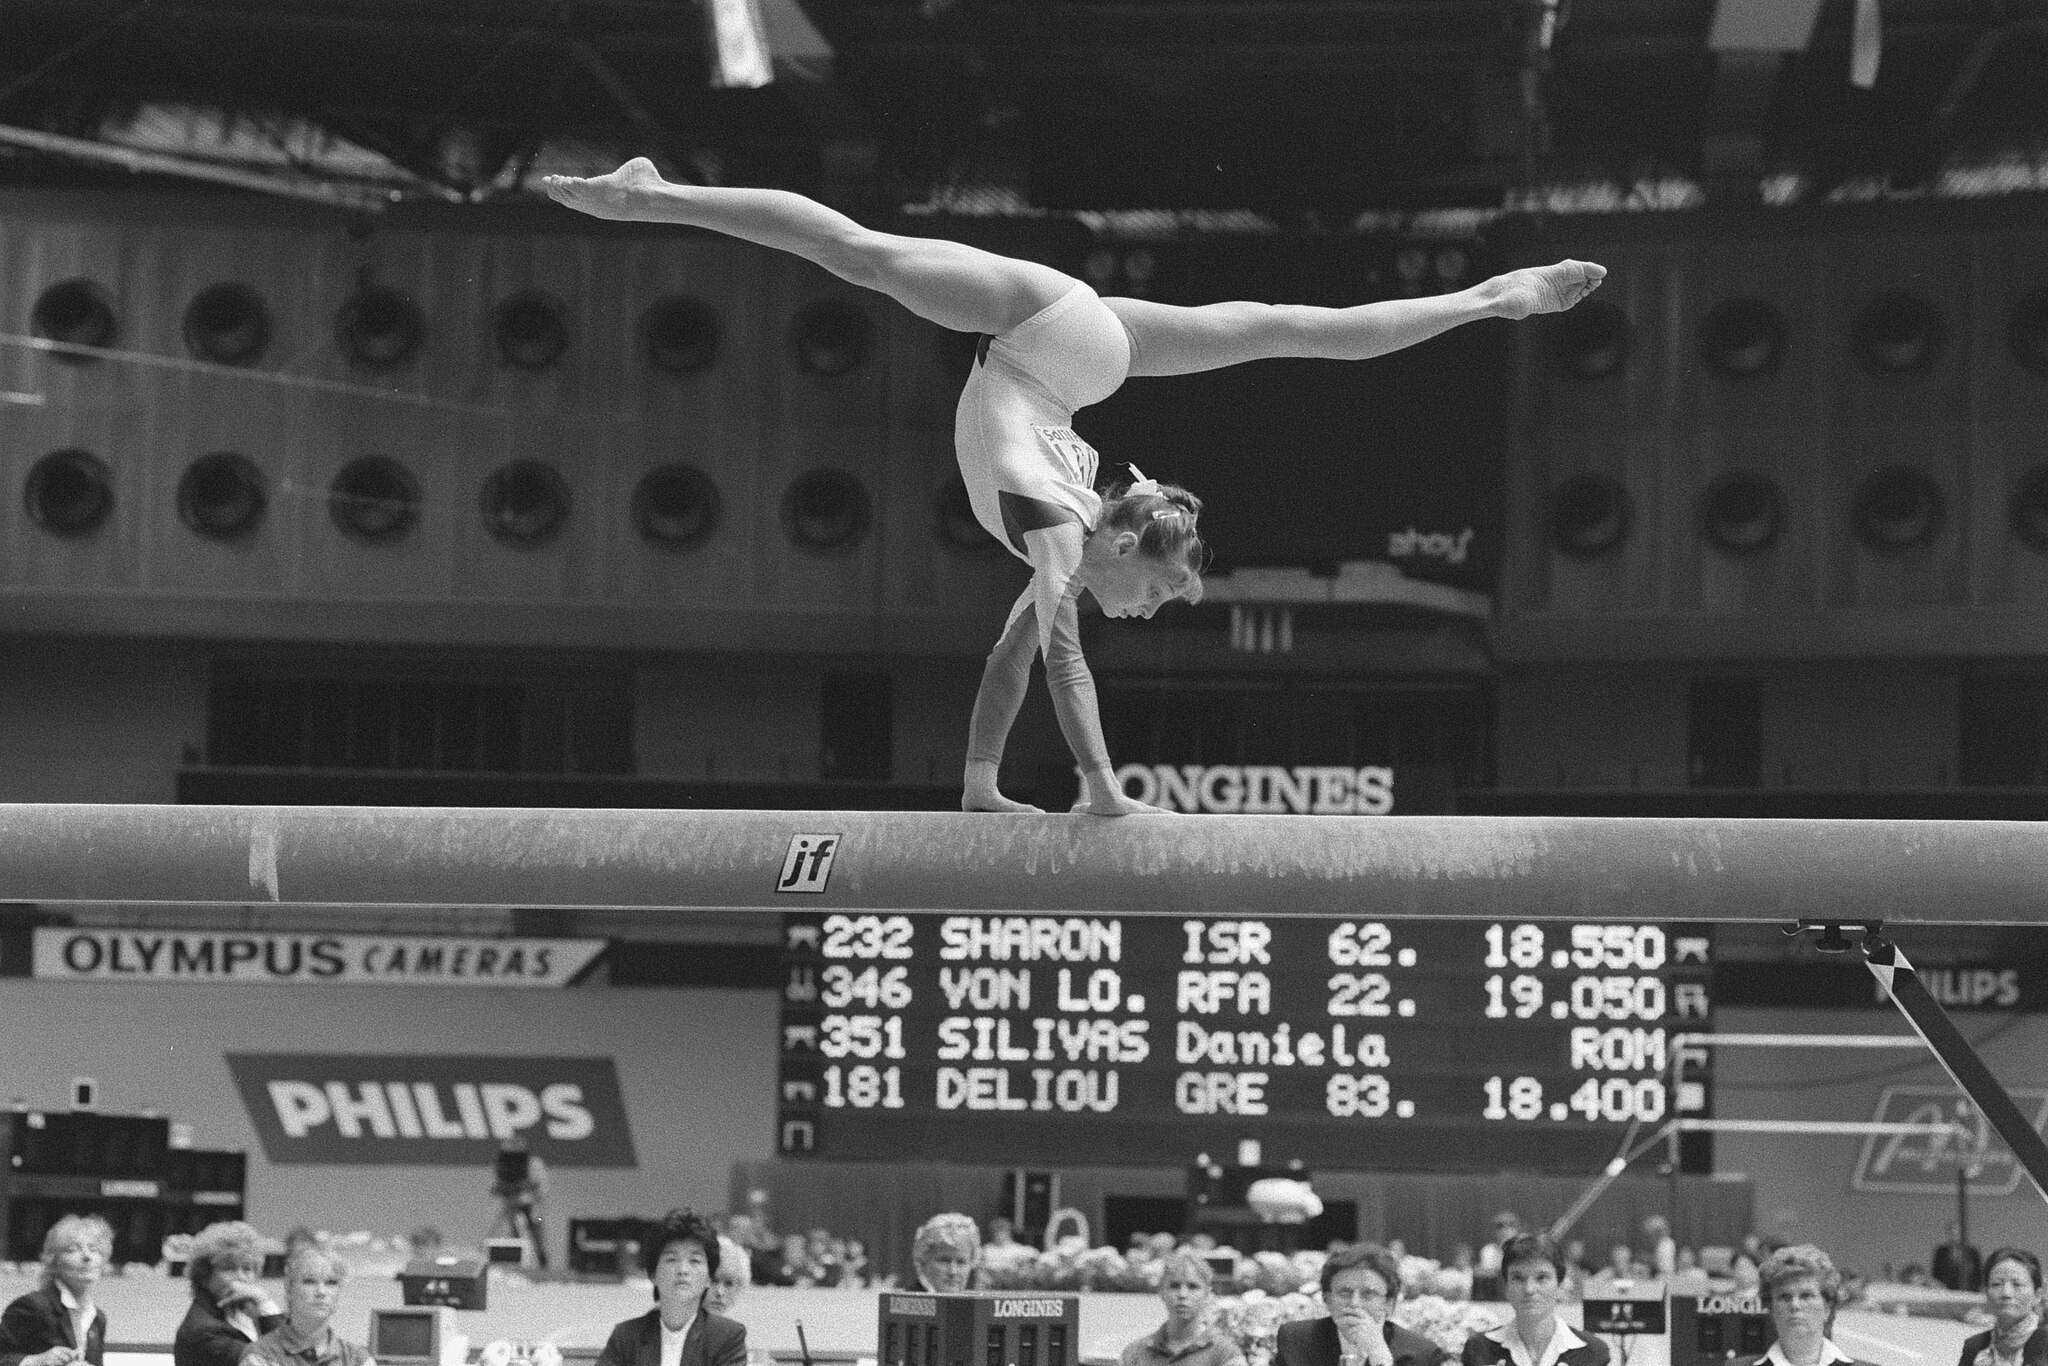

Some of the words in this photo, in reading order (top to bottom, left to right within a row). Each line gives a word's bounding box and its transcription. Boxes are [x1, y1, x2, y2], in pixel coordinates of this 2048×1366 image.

[63, 935, 346, 977] OLYMPUS
[361, 944, 553, 978] CAMERAS
[822, 915, 914, 960] 232
[939, 917, 1122, 962] SHARON
[1183, 920, 1275, 965] ISR
[1328, 922, 1417, 967] 62.
[1484, 923, 1666, 970] 18.550
[822, 965, 913, 1009] 346
[939, 967, 1031, 1010] VON
[1057, 968, 1146, 1013] LO.
[1176, 970, 1271, 1015] RFA
[1327, 973, 1416, 1017] 22.
[1484, 974, 1666, 1020] 19.050
[1876, 969, 2020, 1005] ILIPS
[820, 1015, 906, 1059] 351
[937, 1017, 1150, 1062] SILIVAS
[1176, 1020, 1391, 1067] Daniela
[1570, 1026, 1667, 1072] ROM
[267, 1081, 595, 1140] PHILIPS
[823, 1065, 905, 1108] 181
[936, 1067, 1119, 1112] DELIOU
[1175, 1071, 1269, 1116] GRE
[1326, 1073, 1415, 1118] 83.
[1483, 1076, 1666, 1122] 18.400
[993, 1299, 1064, 1317] LONGINES
